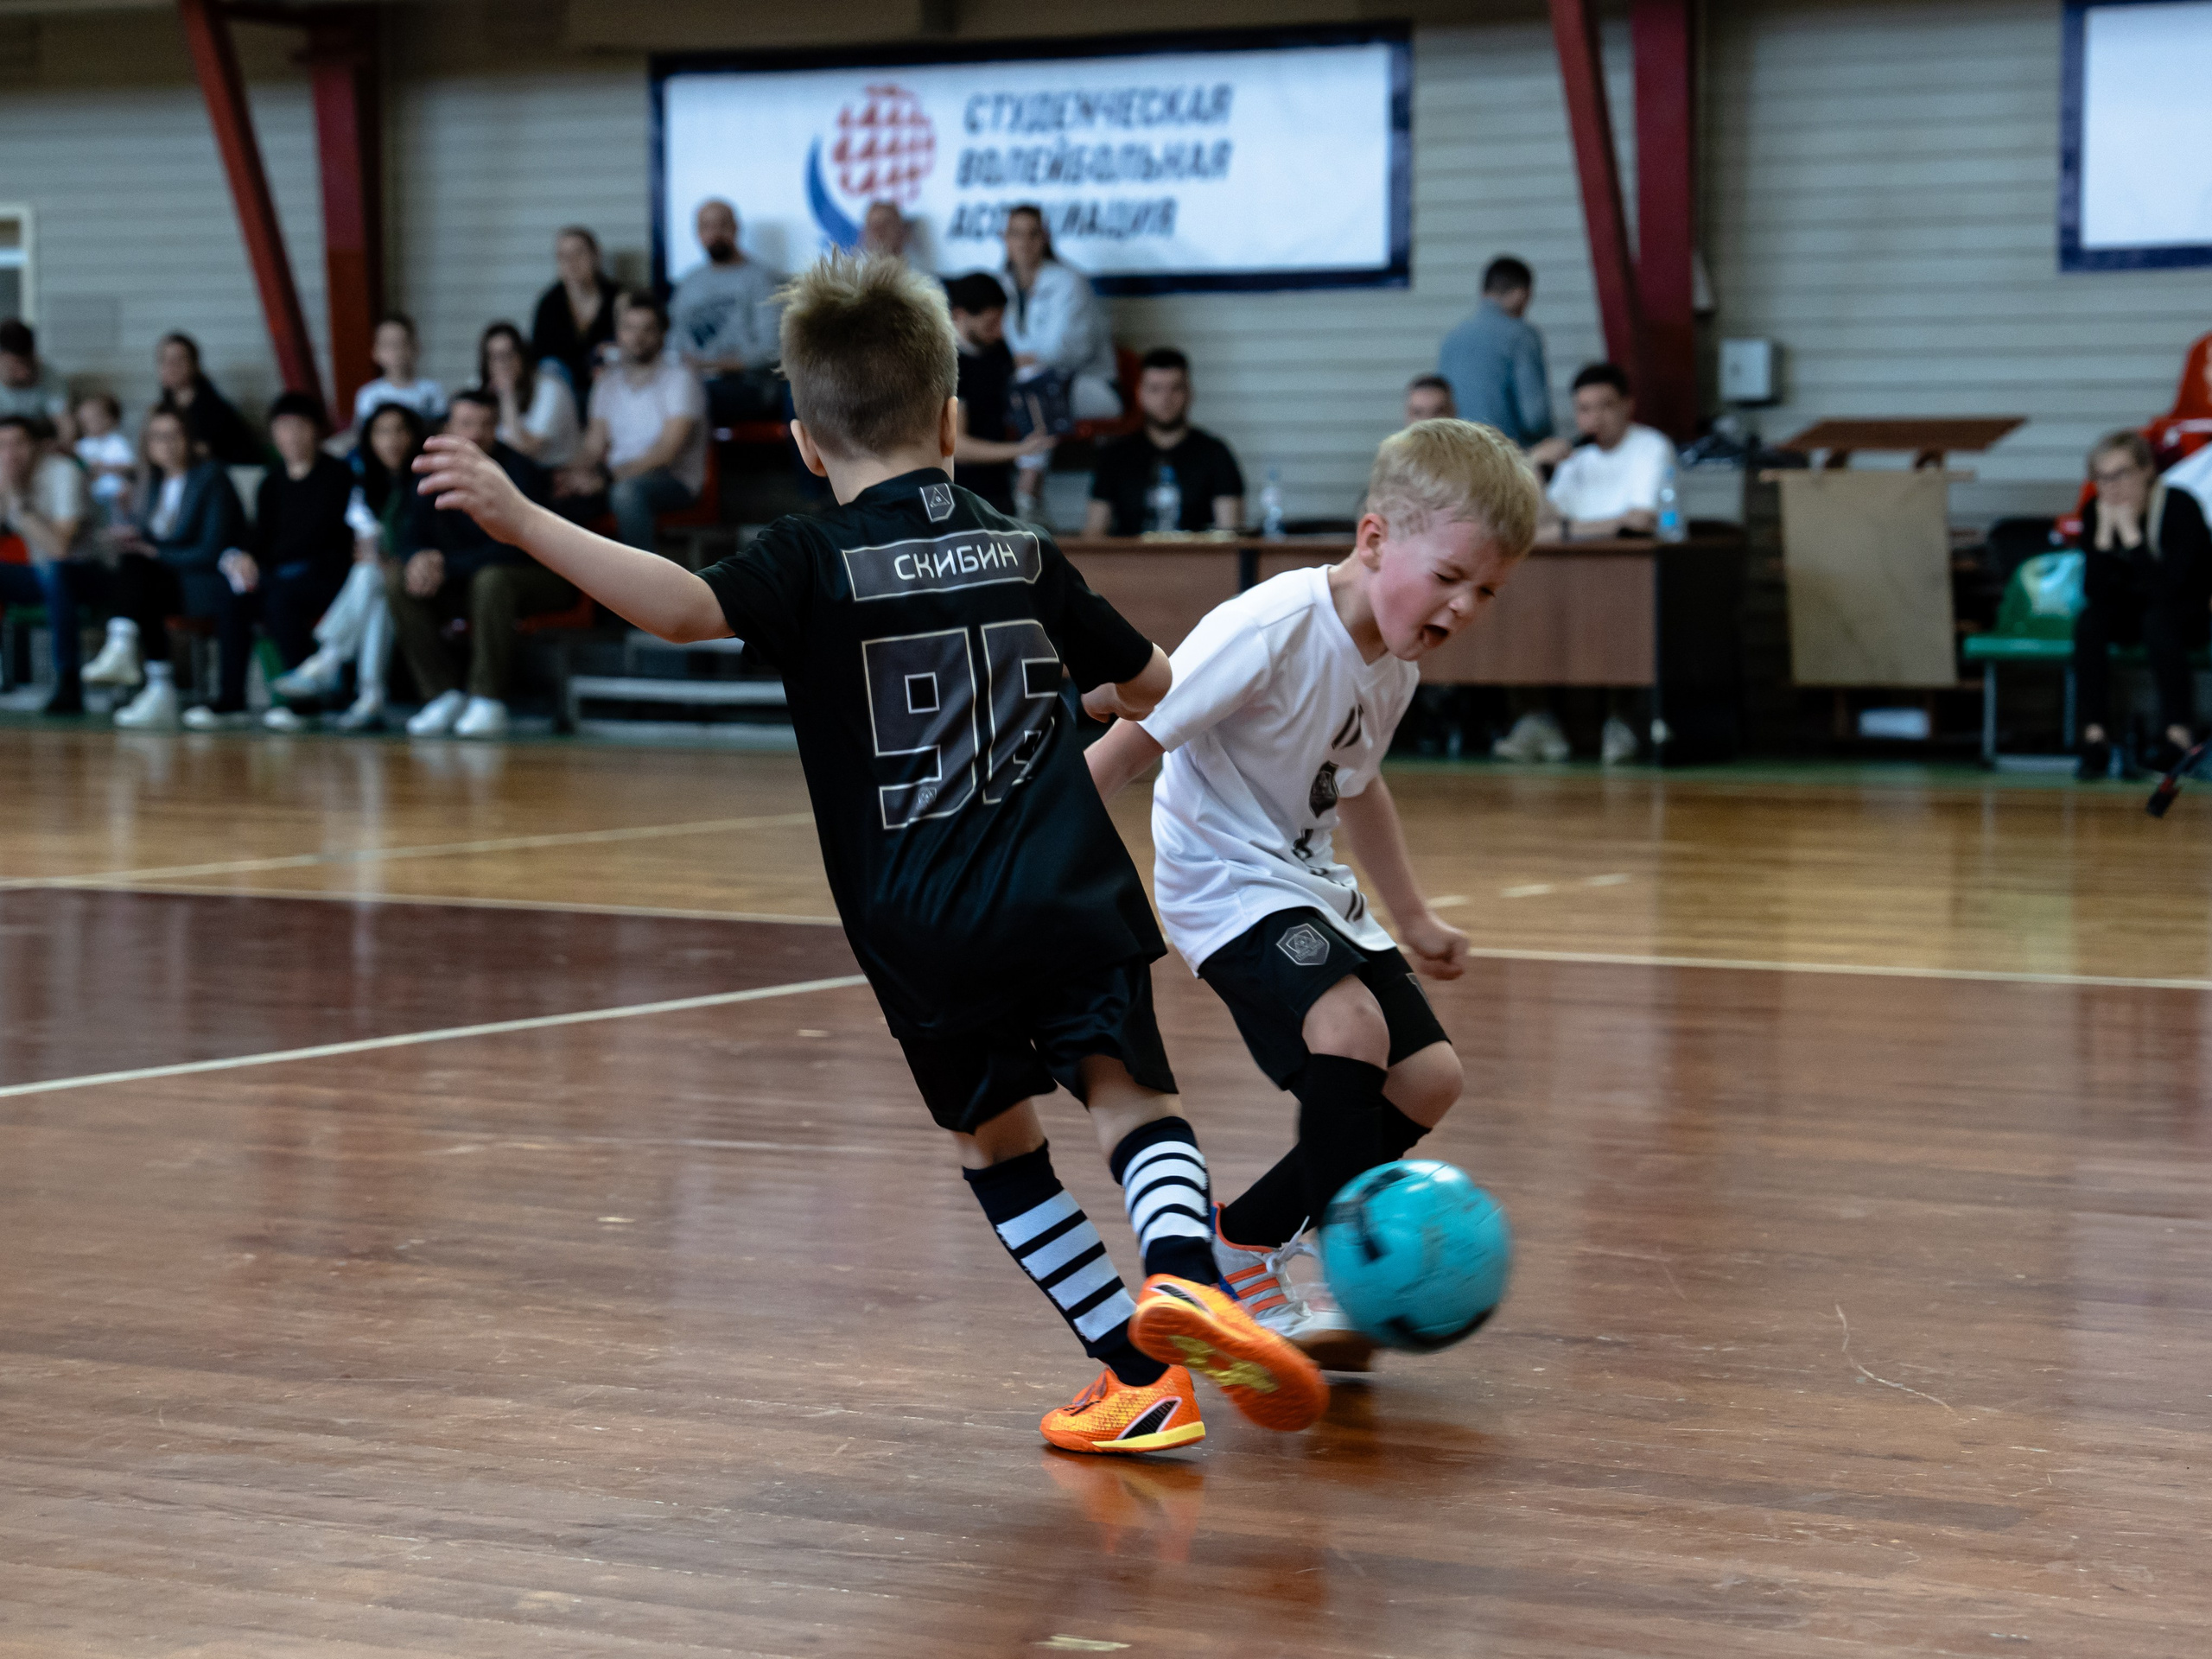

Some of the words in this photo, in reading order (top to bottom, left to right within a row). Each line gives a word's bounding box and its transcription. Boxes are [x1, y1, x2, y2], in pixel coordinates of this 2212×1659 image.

[964, 83, 1233, 134] СТУДЕНЧЕСКАЯ
[957, 138, 1233, 187] ВОЛЕЙБОЛЬНАЯ
[894, 543, 1020, 582] СКИБИН
[861, 620, 1060, 830] 96
